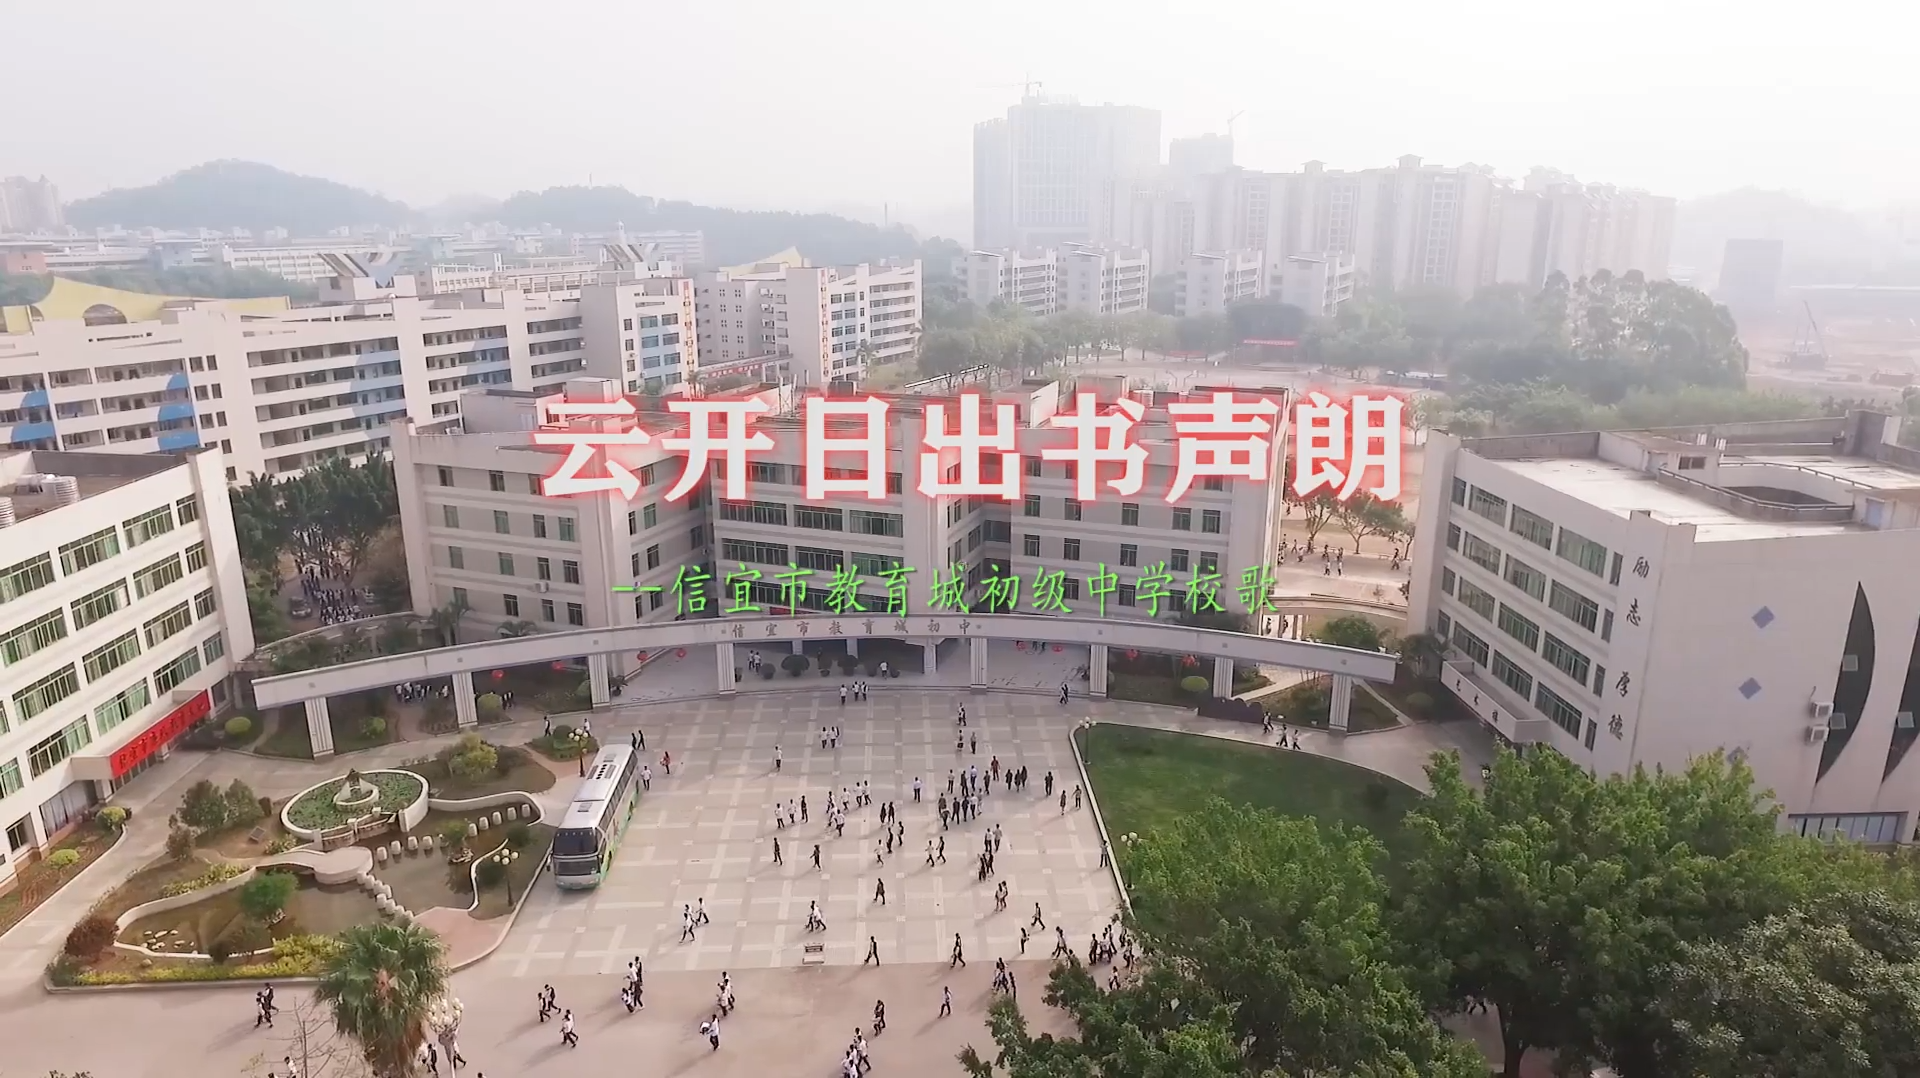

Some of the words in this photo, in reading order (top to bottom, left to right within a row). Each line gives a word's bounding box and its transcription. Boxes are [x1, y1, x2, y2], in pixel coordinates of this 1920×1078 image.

[731, 618, 971, 638] 信宜市教育城初中
